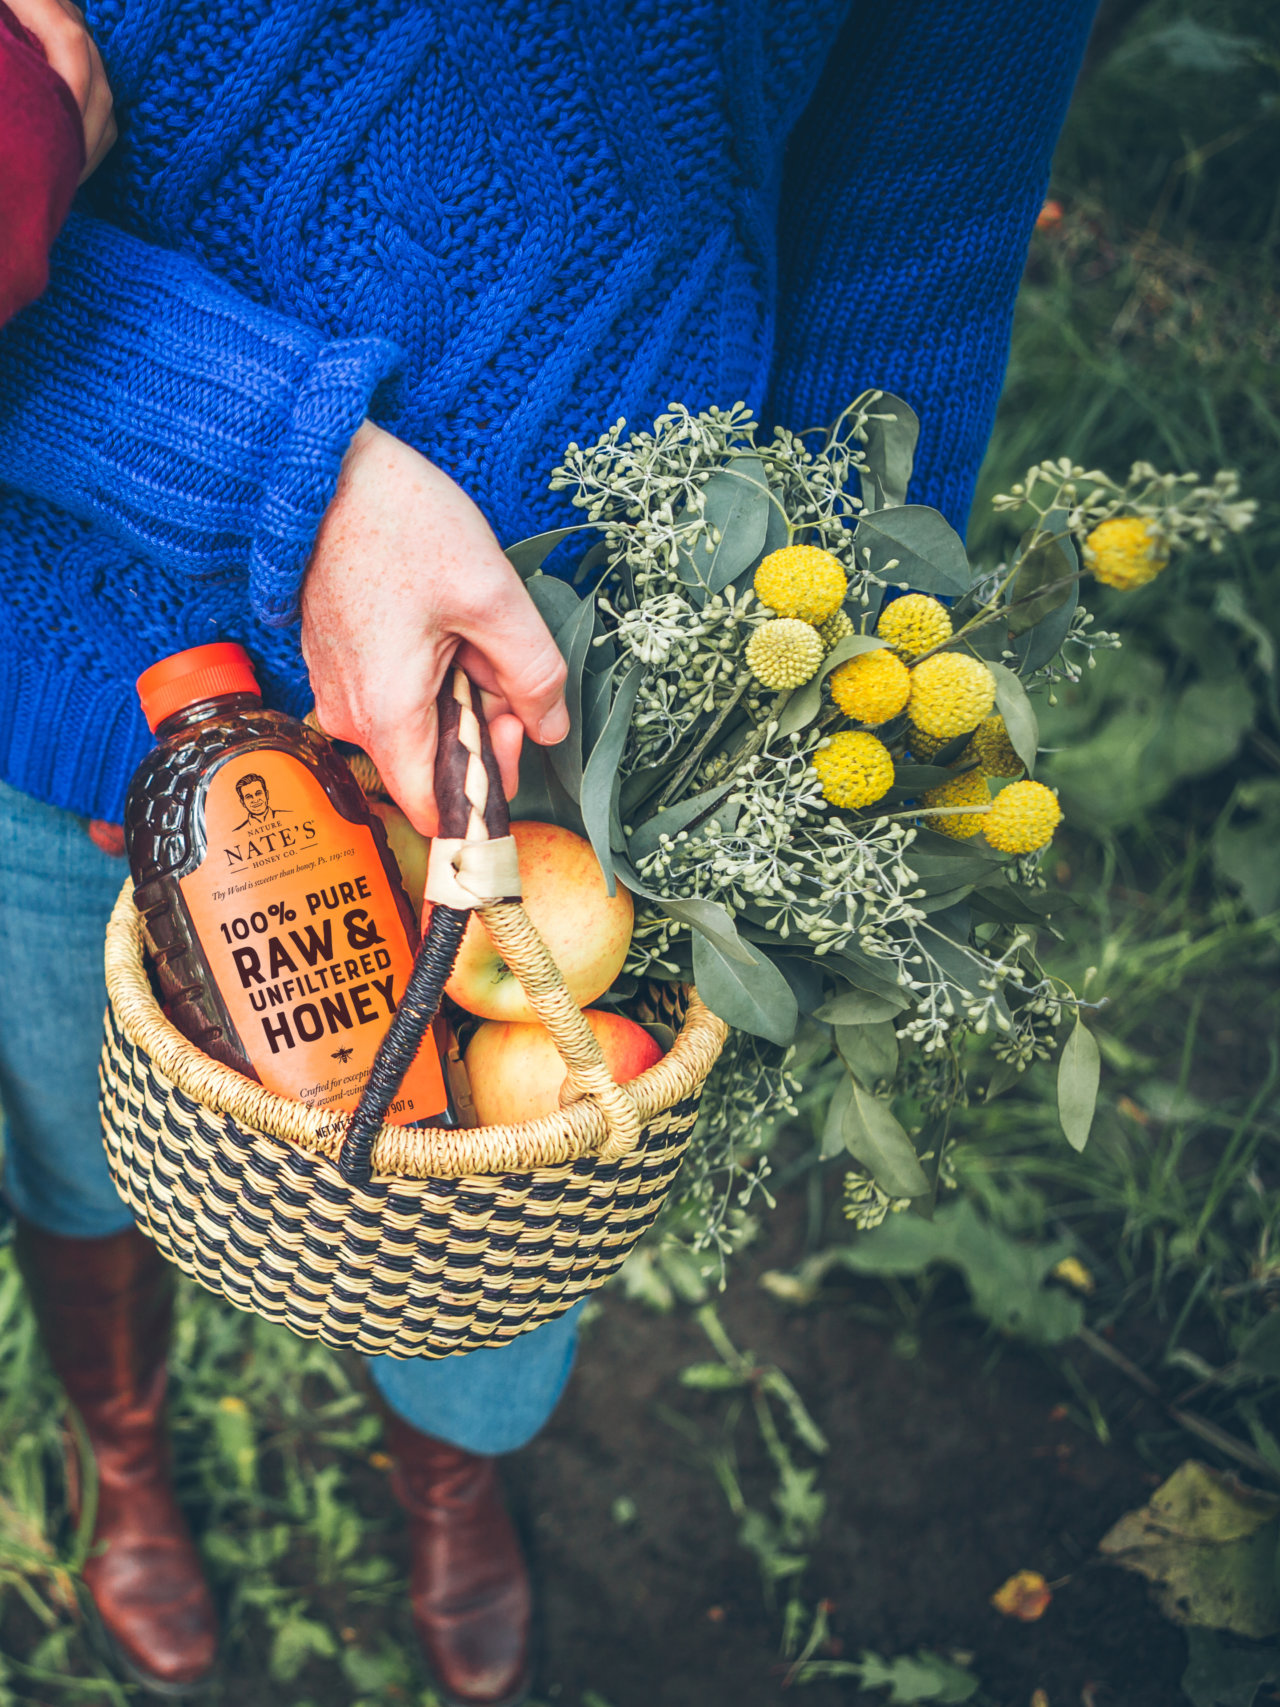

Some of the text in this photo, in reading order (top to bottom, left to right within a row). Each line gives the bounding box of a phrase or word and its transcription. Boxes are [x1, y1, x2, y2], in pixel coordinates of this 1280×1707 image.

[223, 820, 317, 866] NATE'S
[248, 822, 282, 837] NATURE
[212, 848, 356, 901] Thy Word is sweeter than honey. Ps. 119:103
[252, 850, 298, 869] HONEY CO.
[220, 876, 372, 944] 100% PURE
[232, 908, 387, 989] RAW &
[248, 948, 392, 1012] UNFILTERED
[261, 974, 398, 1054] HONEY
[299, 1081, 330, 1098] Crafted
[330, 1078, 343, 1092] for
[315, 1125, 331, 1139] NET
[331, 1120, 346, 1134] WT
[390, 1099, 406, 1114] 907
[407, 1099, 415, 1110] g
